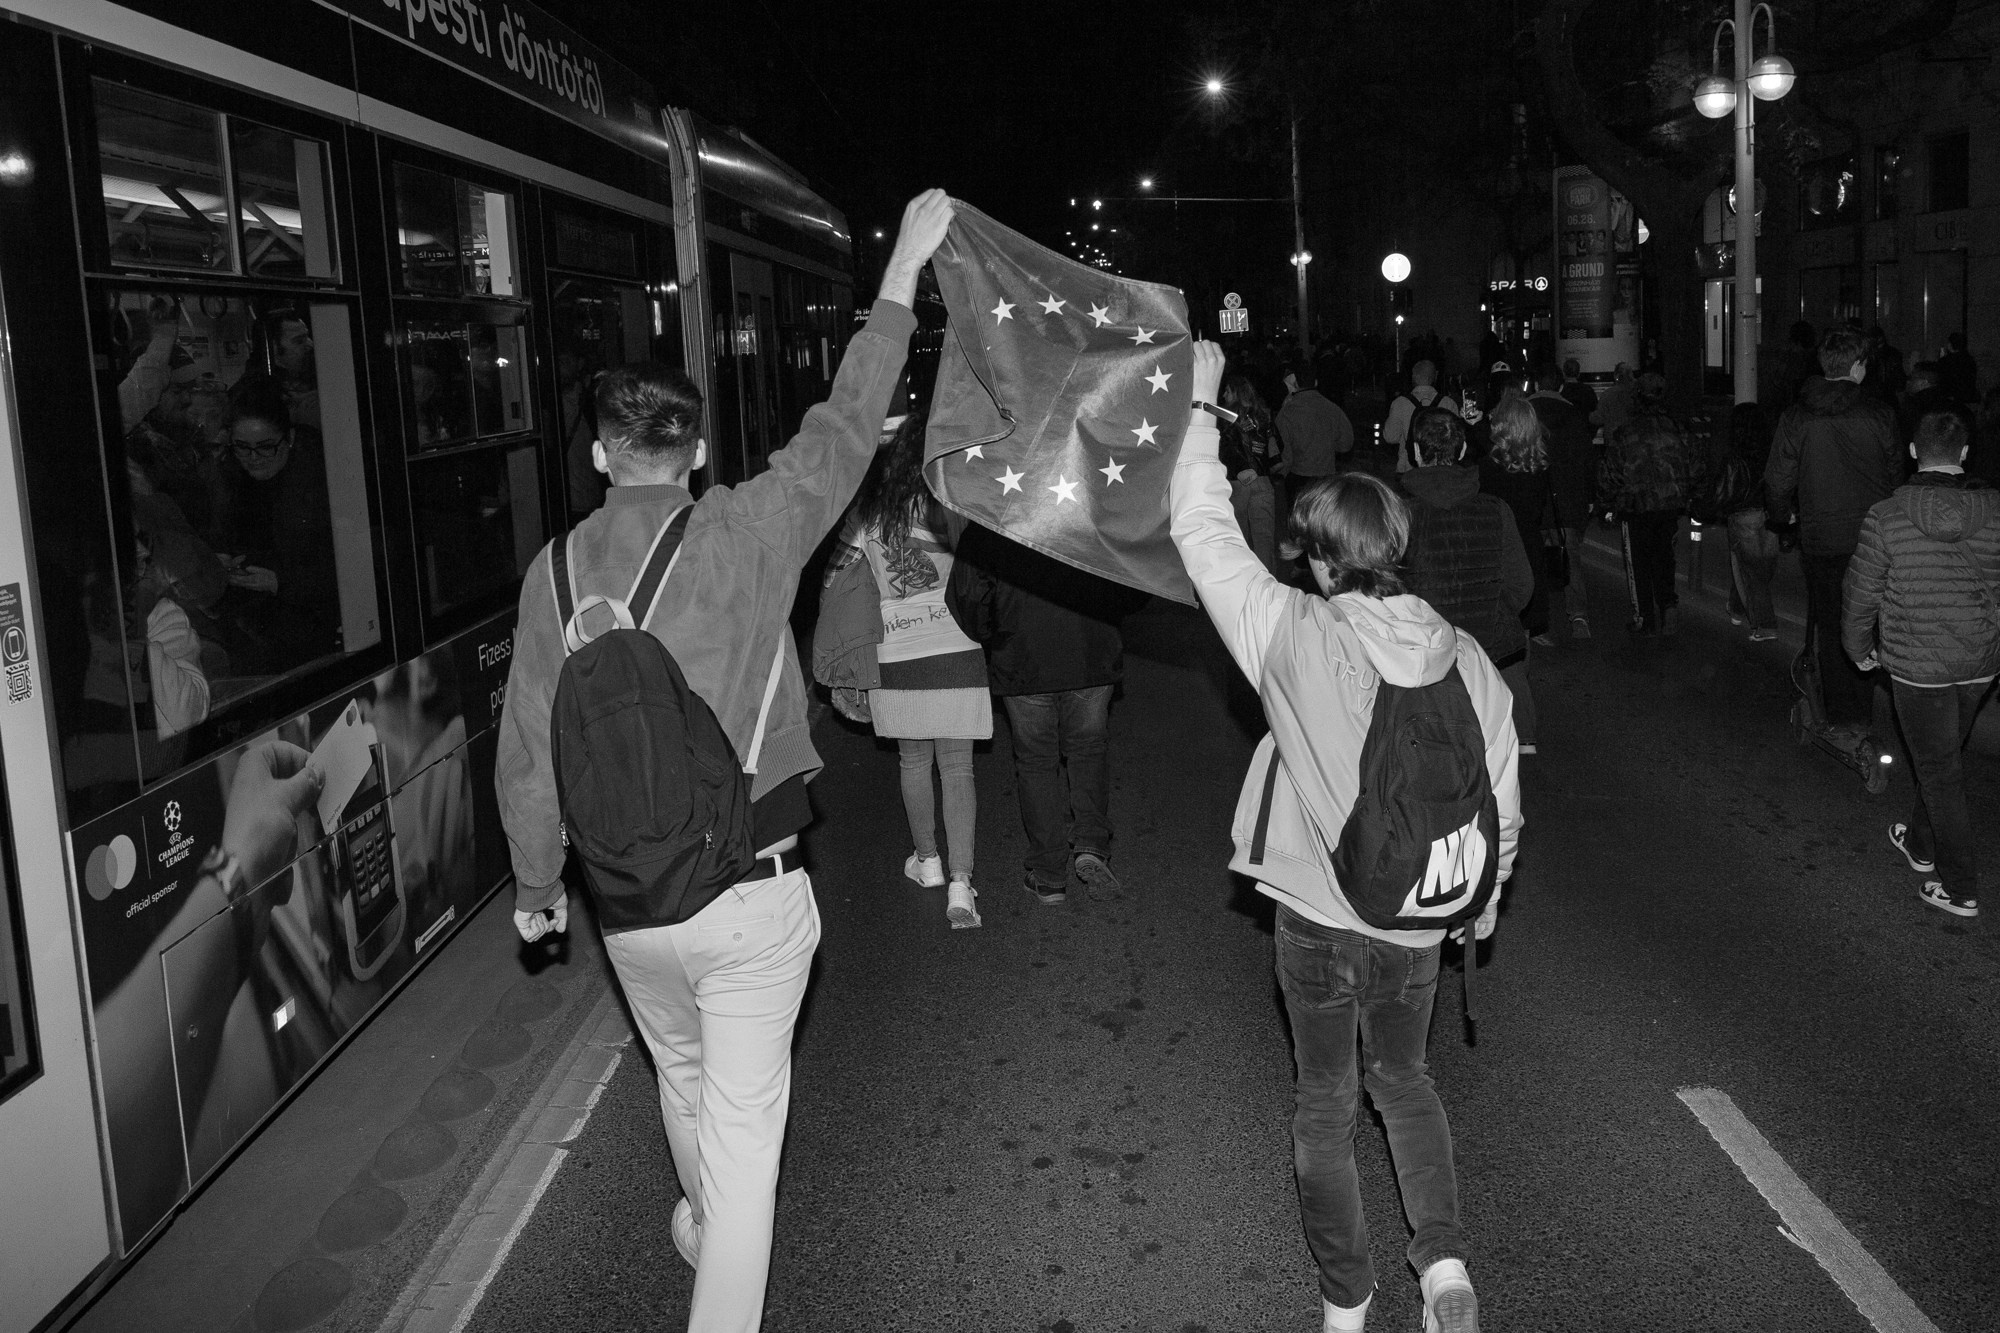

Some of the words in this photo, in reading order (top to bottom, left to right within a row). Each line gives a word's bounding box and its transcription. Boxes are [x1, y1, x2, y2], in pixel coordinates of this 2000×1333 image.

[382, 0, 492, 58] pesti
[1490, 279, 1533, 291] SPAR
[1569, 262, 1605, 278] GRUND
[478, 638, 511, 671] Fizess
[1332, 656, 1382, 691] TRU
[158, 835, 195, 863] CHAMPIONS
[165, 848, 190, 868] LEAGUE
[126, 895, 151, 919] official
[151, 880, 178, 903] sponsor
